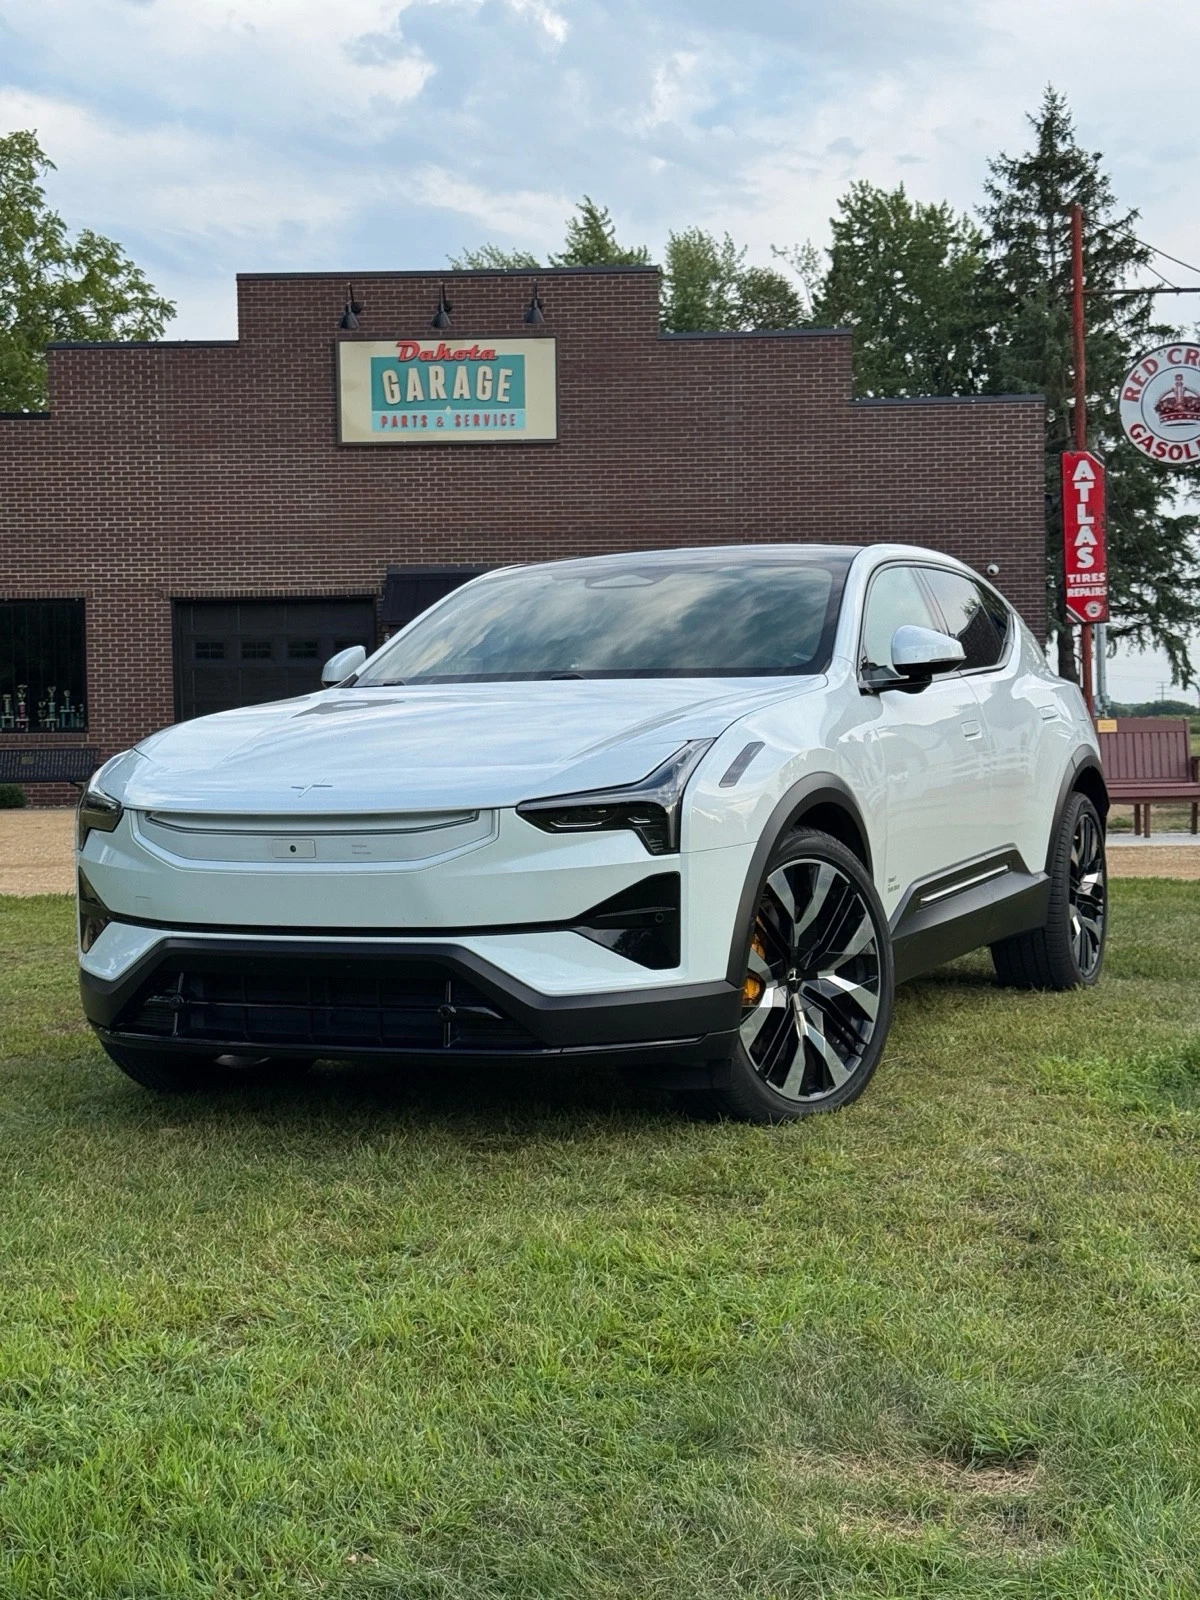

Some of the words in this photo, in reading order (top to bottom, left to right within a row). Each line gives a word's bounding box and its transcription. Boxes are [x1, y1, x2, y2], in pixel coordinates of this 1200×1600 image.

[396, 340, 499, 362] Dakota
[382, 365, 513, 405] GARAGE
[1123, 359, 1159, 402] RED
[1167, 348, 1200, 366] CR
[381, 415, 428, 428] PARTS
[436, 416, 444, 428] &
[455, 414, 516, 428] SERVICE
[1072, 460, 1098, 568] ATLAS
[1067, 573, 1106, 583] TIRES
[1067, 587, 1107, 597] REPAIRS
